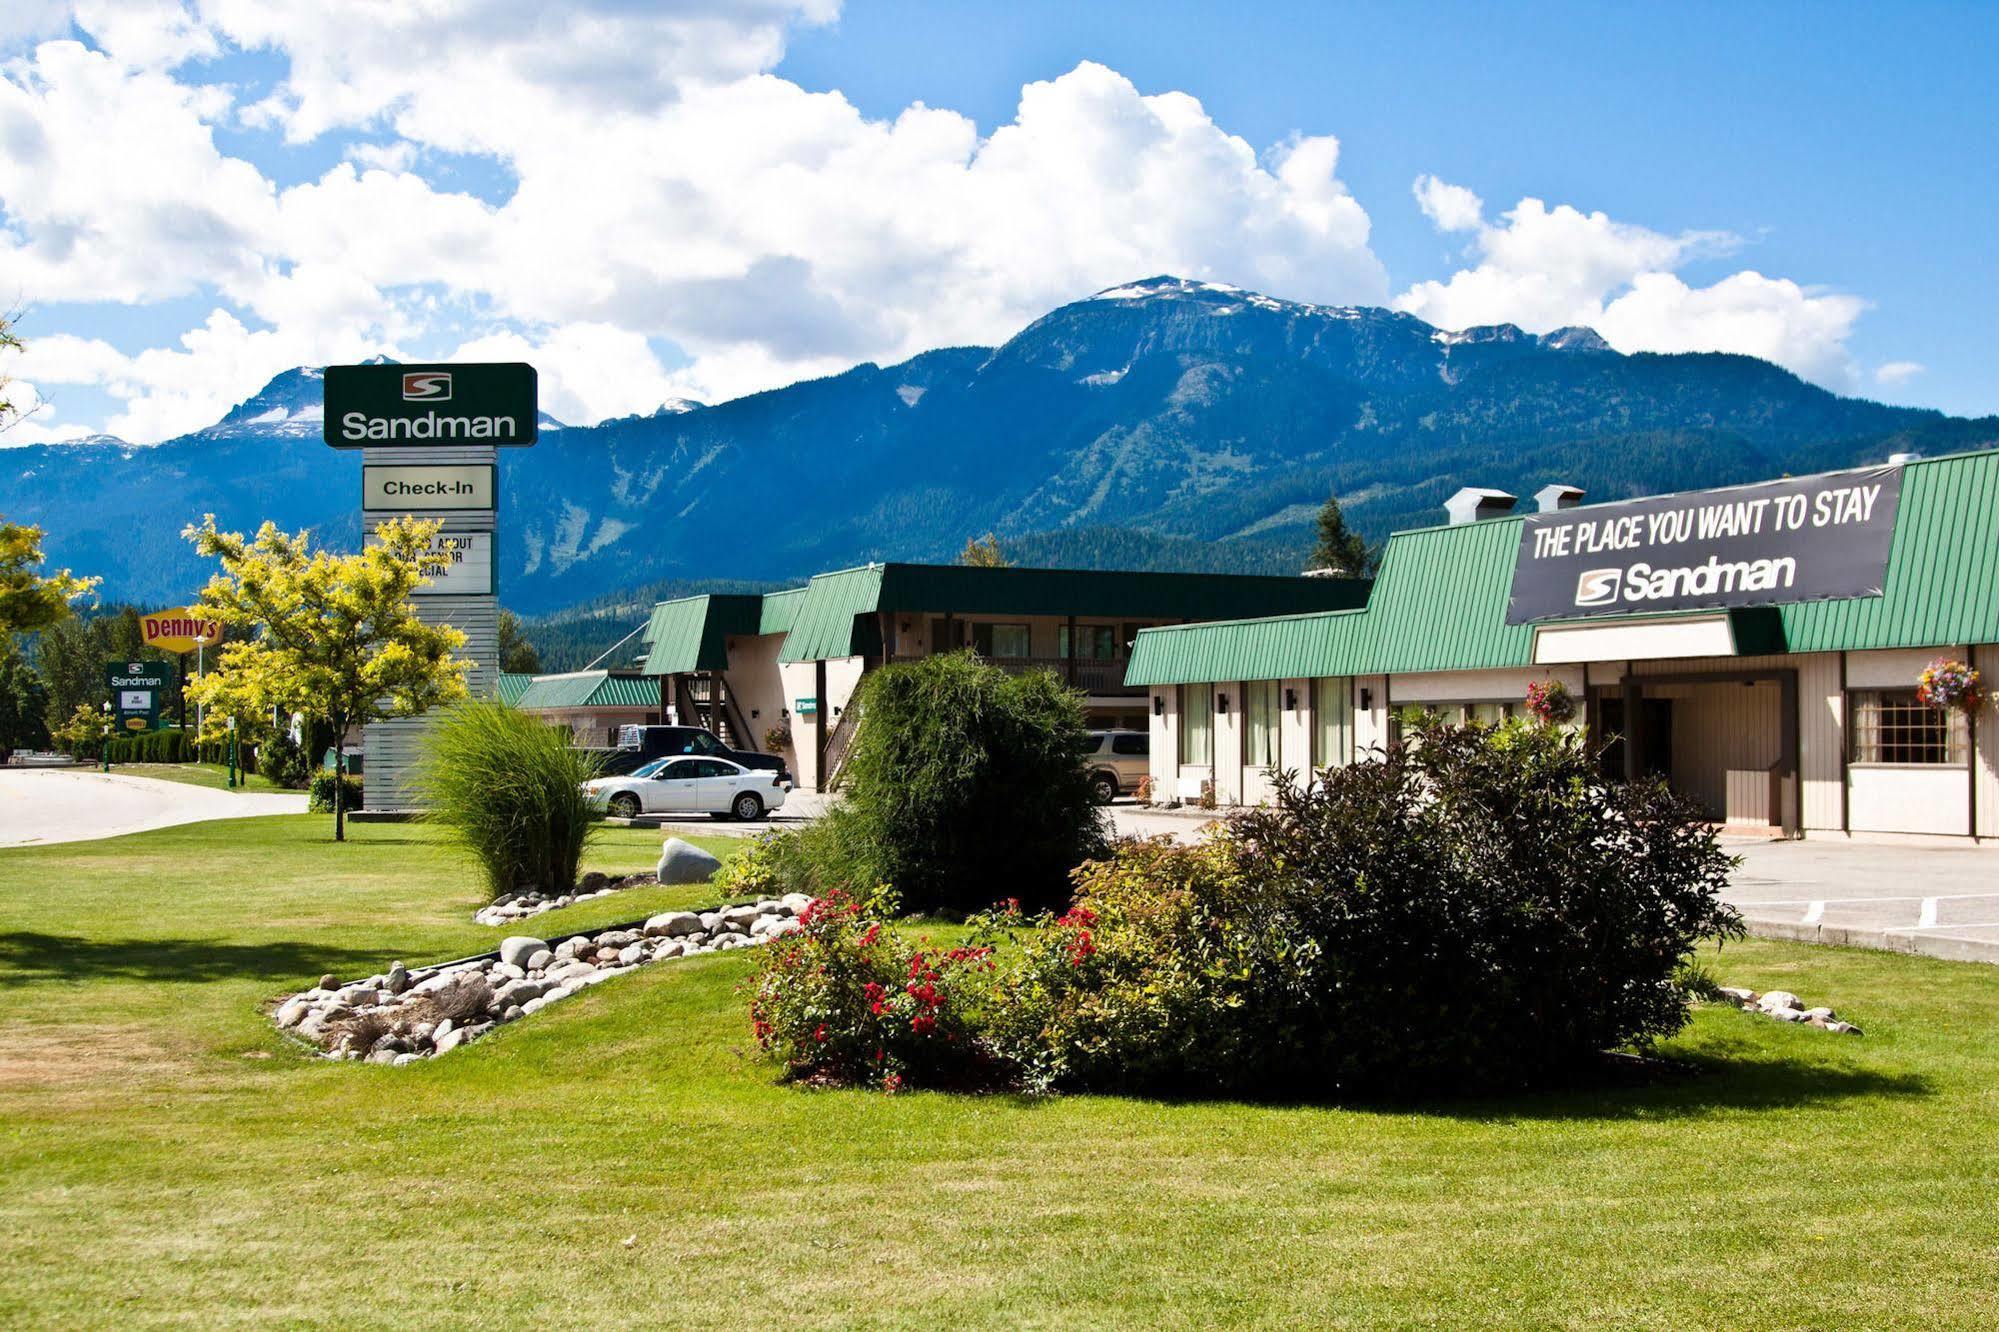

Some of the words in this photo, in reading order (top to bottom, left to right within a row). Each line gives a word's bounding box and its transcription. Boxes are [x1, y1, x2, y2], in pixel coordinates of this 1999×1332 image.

[342, 411, 516, 440] Sandman
[383, 481, 474, 495] Check-In
[1534, 525, 1573, 559] THE
[1574, 515, 1645, 555] PLACE
[1648, 508, 1694, 546] YOU
[1698, 499, 1770, 540] WANT
[1774, 494, 1807, 531] TO
[1813, 484, 1881, 528] STAY
[417, 564, 449, 577] ECIAL
[1623, 555, 1796, 601] Sandman
[145, 618, 217, 640] Dennys
[111, 676, 162, 686] Sandman
